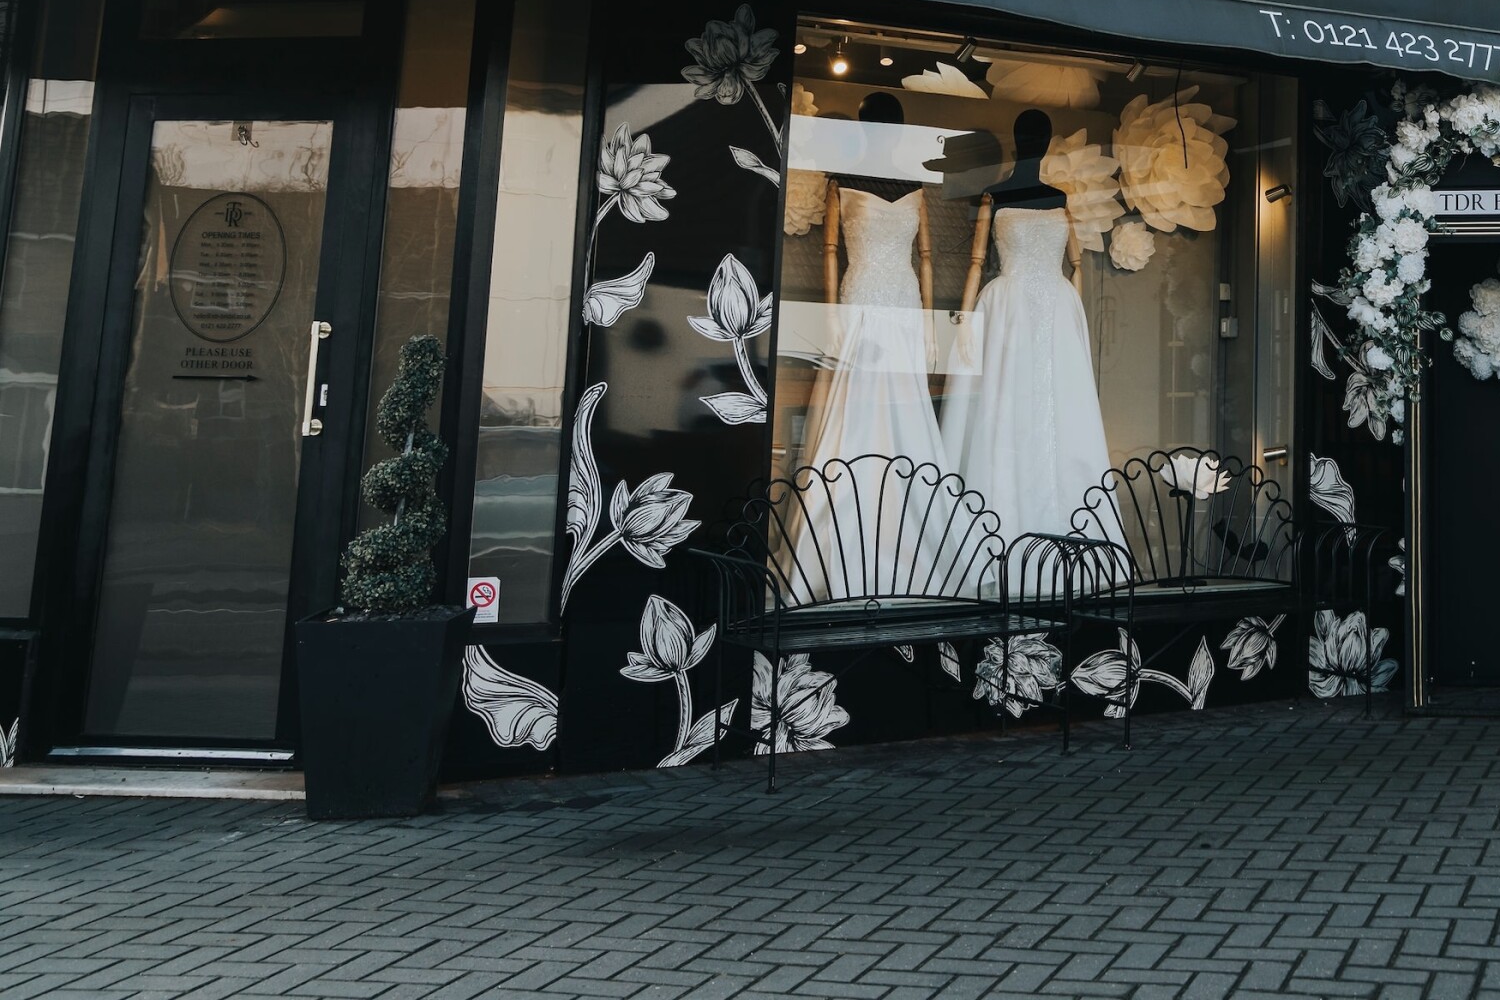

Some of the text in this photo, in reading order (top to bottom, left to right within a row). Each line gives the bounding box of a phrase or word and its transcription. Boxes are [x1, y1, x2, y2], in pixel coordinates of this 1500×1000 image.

[1259, 10, 1296, 40] T:
[1303, 20, 1378, 50] 0121
[1385, 31, 1440, 62] 423
[1439, 193, 1486, 212] TDR
[201, 231, 261, 239] OPENING TIMES
[185, 347, 252, 357] PLEASE USE
[180, 360, 253, 370] OTHER DOOR
